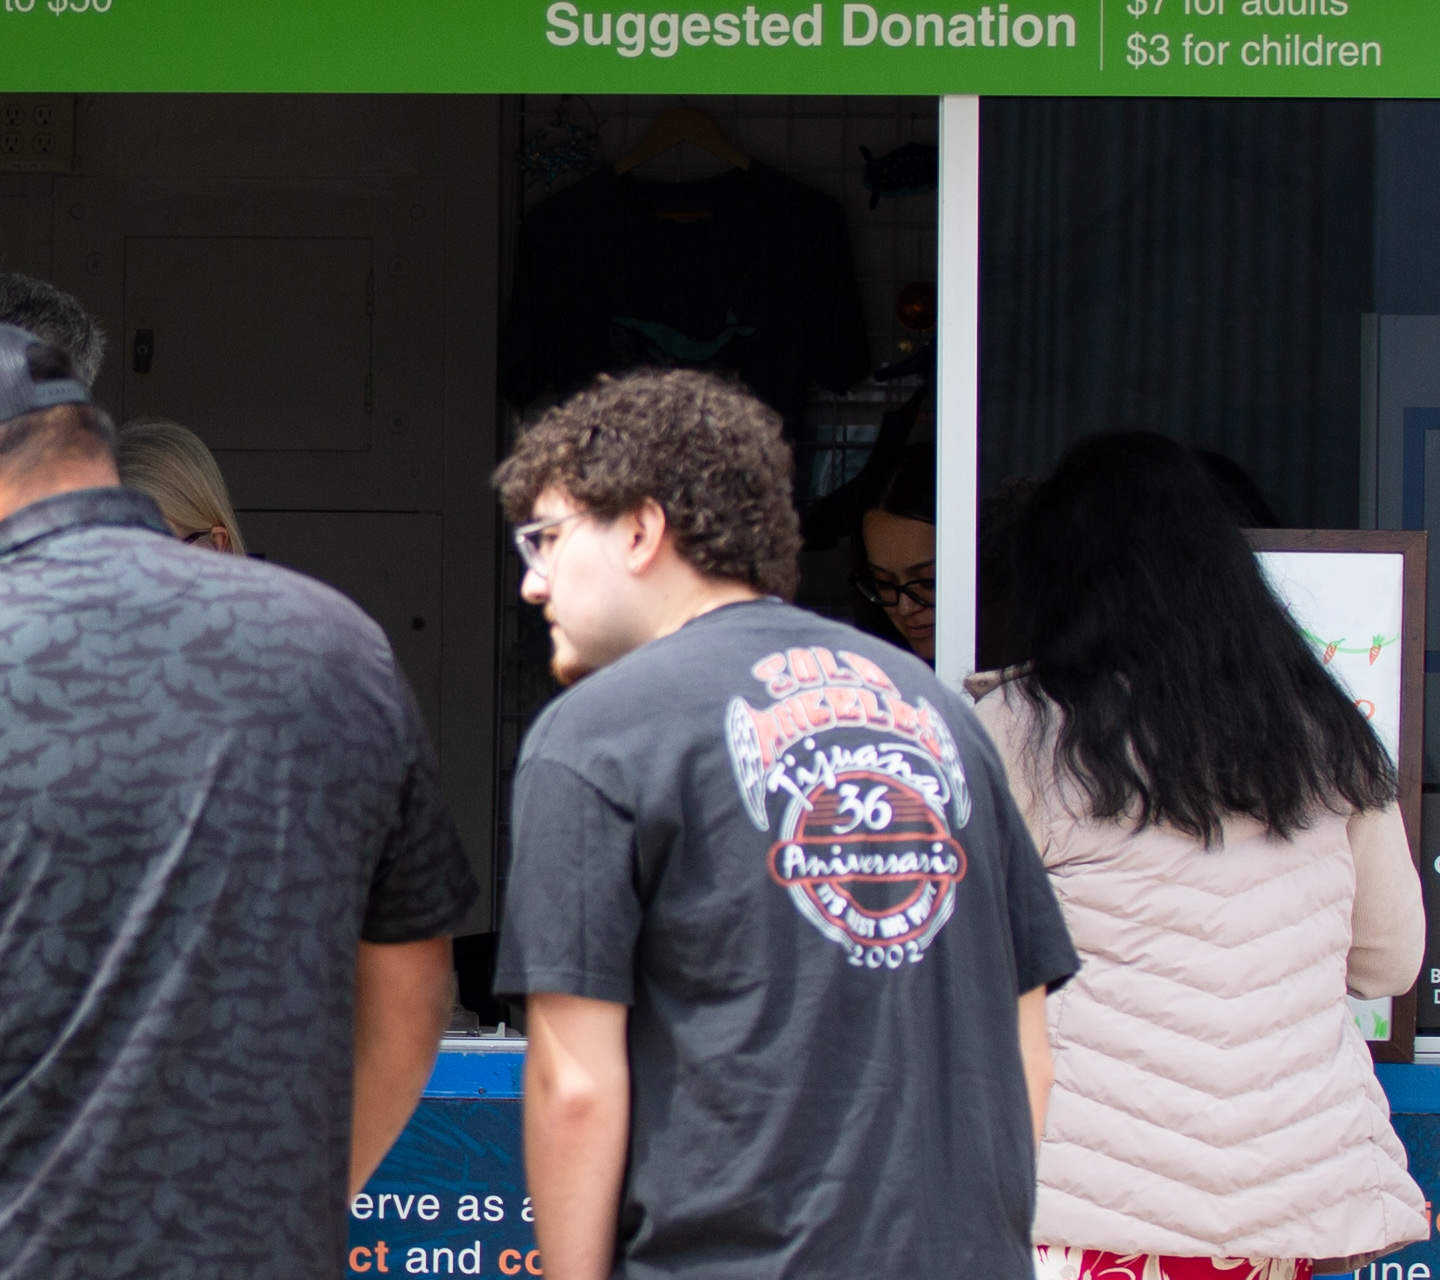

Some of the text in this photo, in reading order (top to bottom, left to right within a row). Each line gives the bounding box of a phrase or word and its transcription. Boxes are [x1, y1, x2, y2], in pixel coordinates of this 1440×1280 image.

[546, 2, 1075, 57] Suggested Donation
[1127, 32, 1381, 69] $3 for children
[833, 784, 892, 832] 36
[784, 842, 958, 879] Aniversario
[848, 940, 924, 969] 2002
[351, 1192, 441, 1221] erve
[457, 1194, 504, 1221] as
[406, 1241, 481, 1274] and
